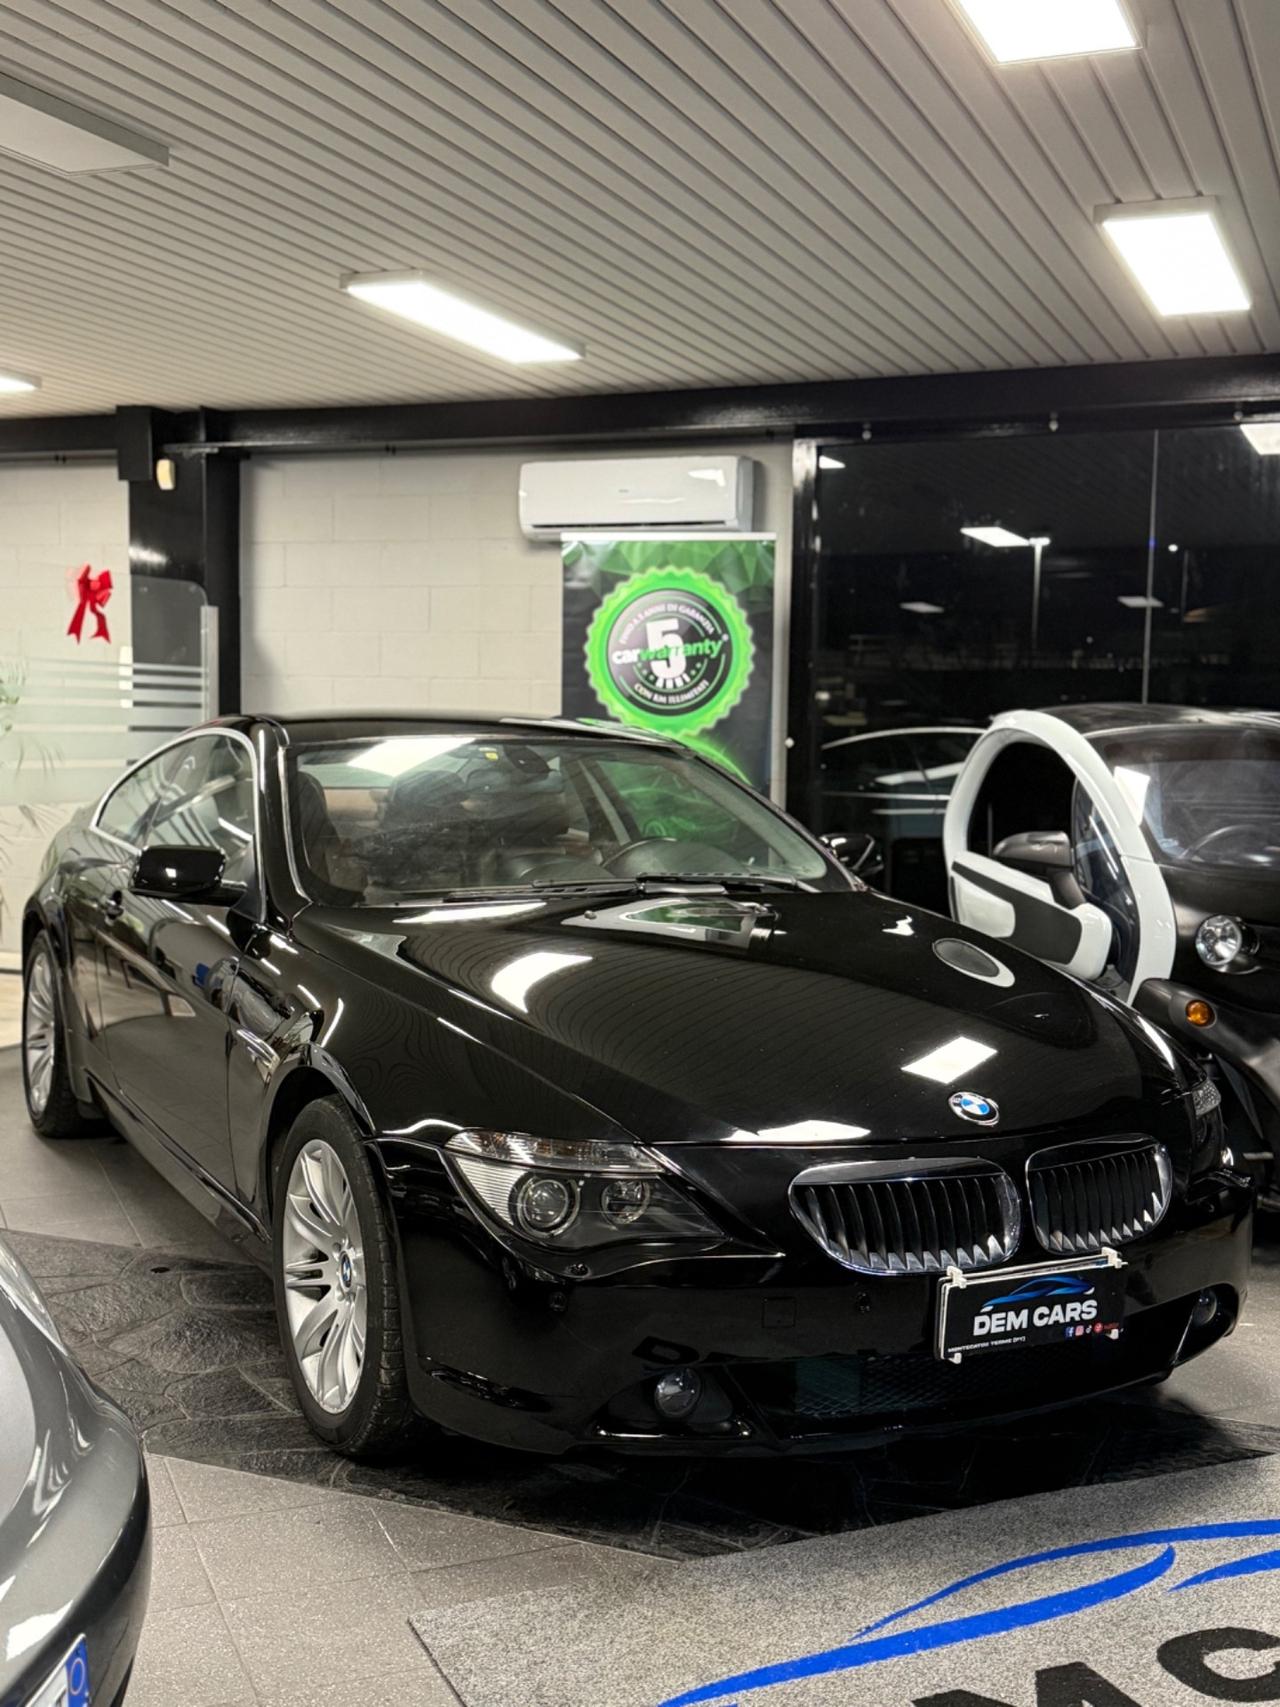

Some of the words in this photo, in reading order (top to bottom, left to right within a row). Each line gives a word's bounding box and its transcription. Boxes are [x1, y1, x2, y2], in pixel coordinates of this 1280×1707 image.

[646, 618, 687, 679] 5
[973, 1308, 1029, 1336] DEM
[1032, 1299, 1098, 1327] CARS
